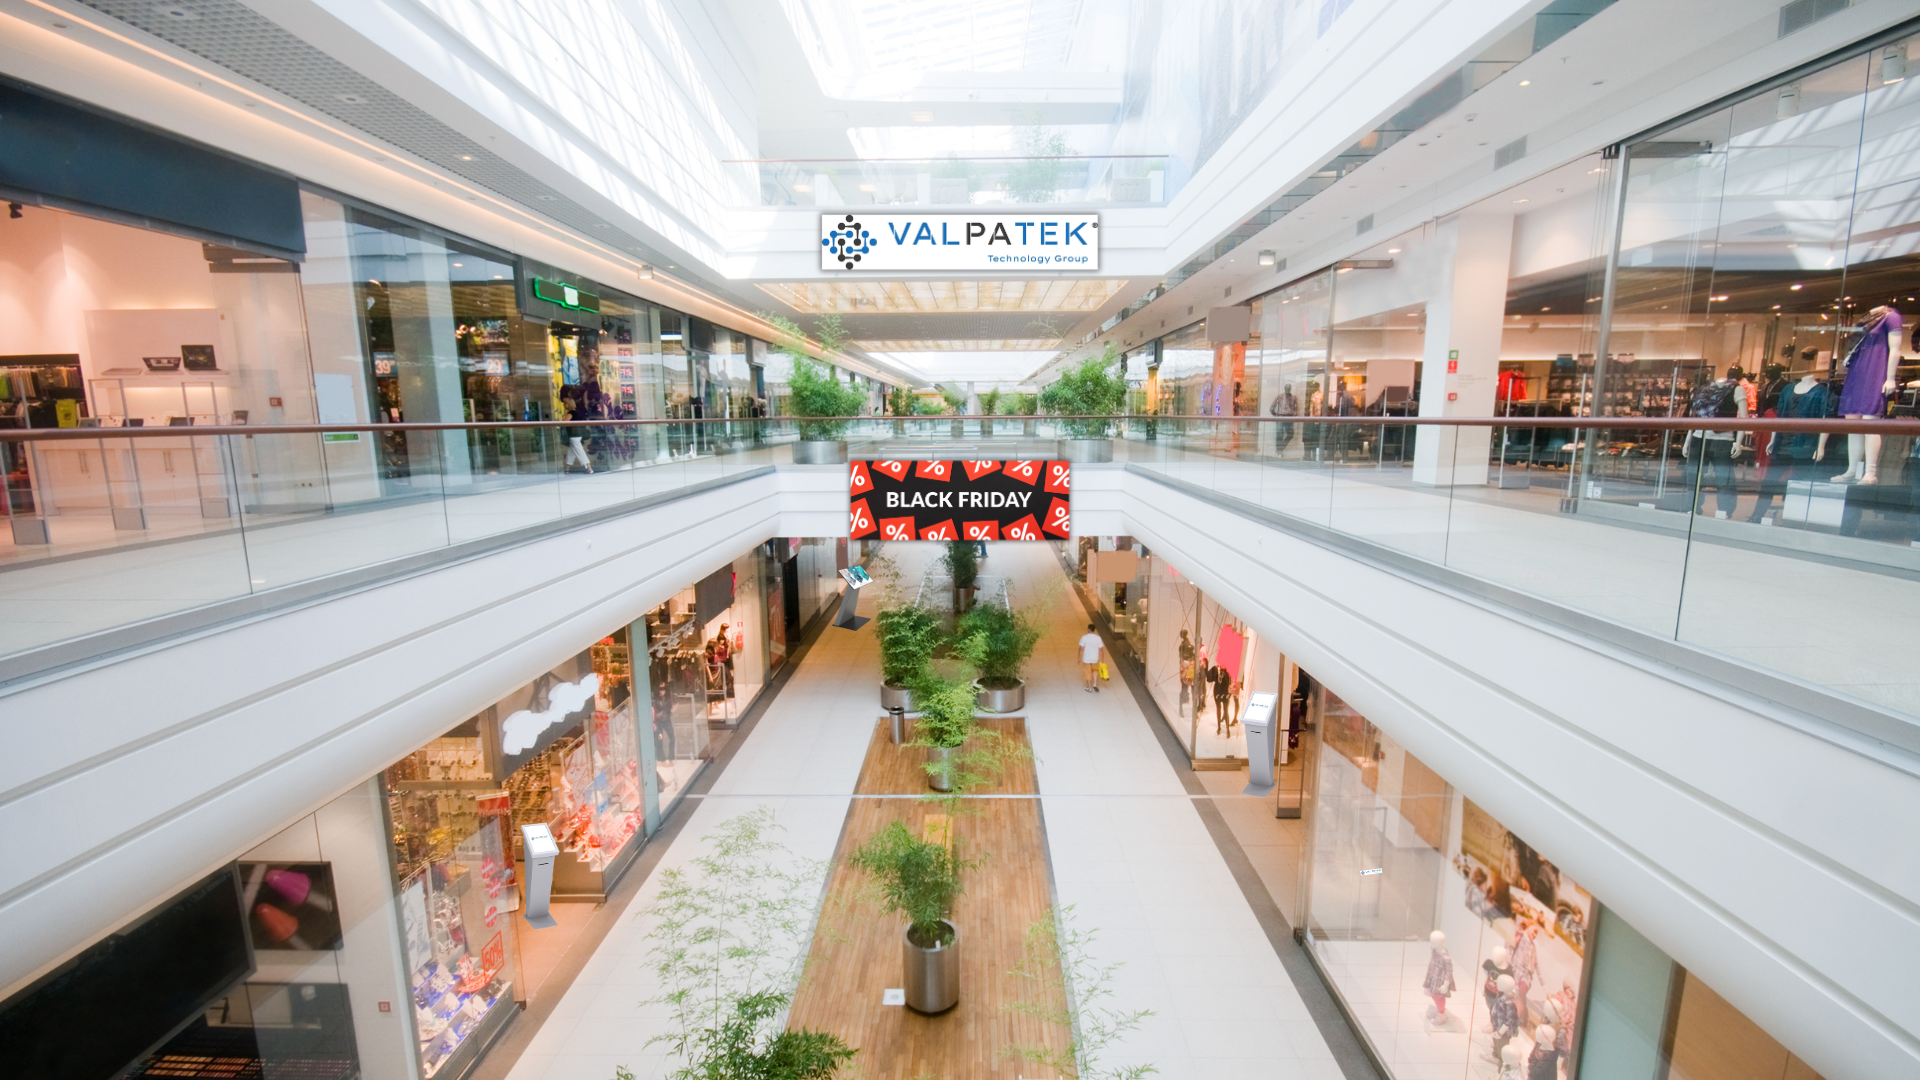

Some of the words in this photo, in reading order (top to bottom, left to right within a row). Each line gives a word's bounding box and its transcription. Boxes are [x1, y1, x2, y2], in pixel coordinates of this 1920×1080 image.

[888, 222, 1088, 245] VALPATEK
[988, 255, 1051, 264] Technology
[1054, 255, 1089, 264] Group
[886, 491, 953, 508] BLACK
[958, 491, 1032, 508] FRIDAY
[485, 939, 502, 973] 50%
